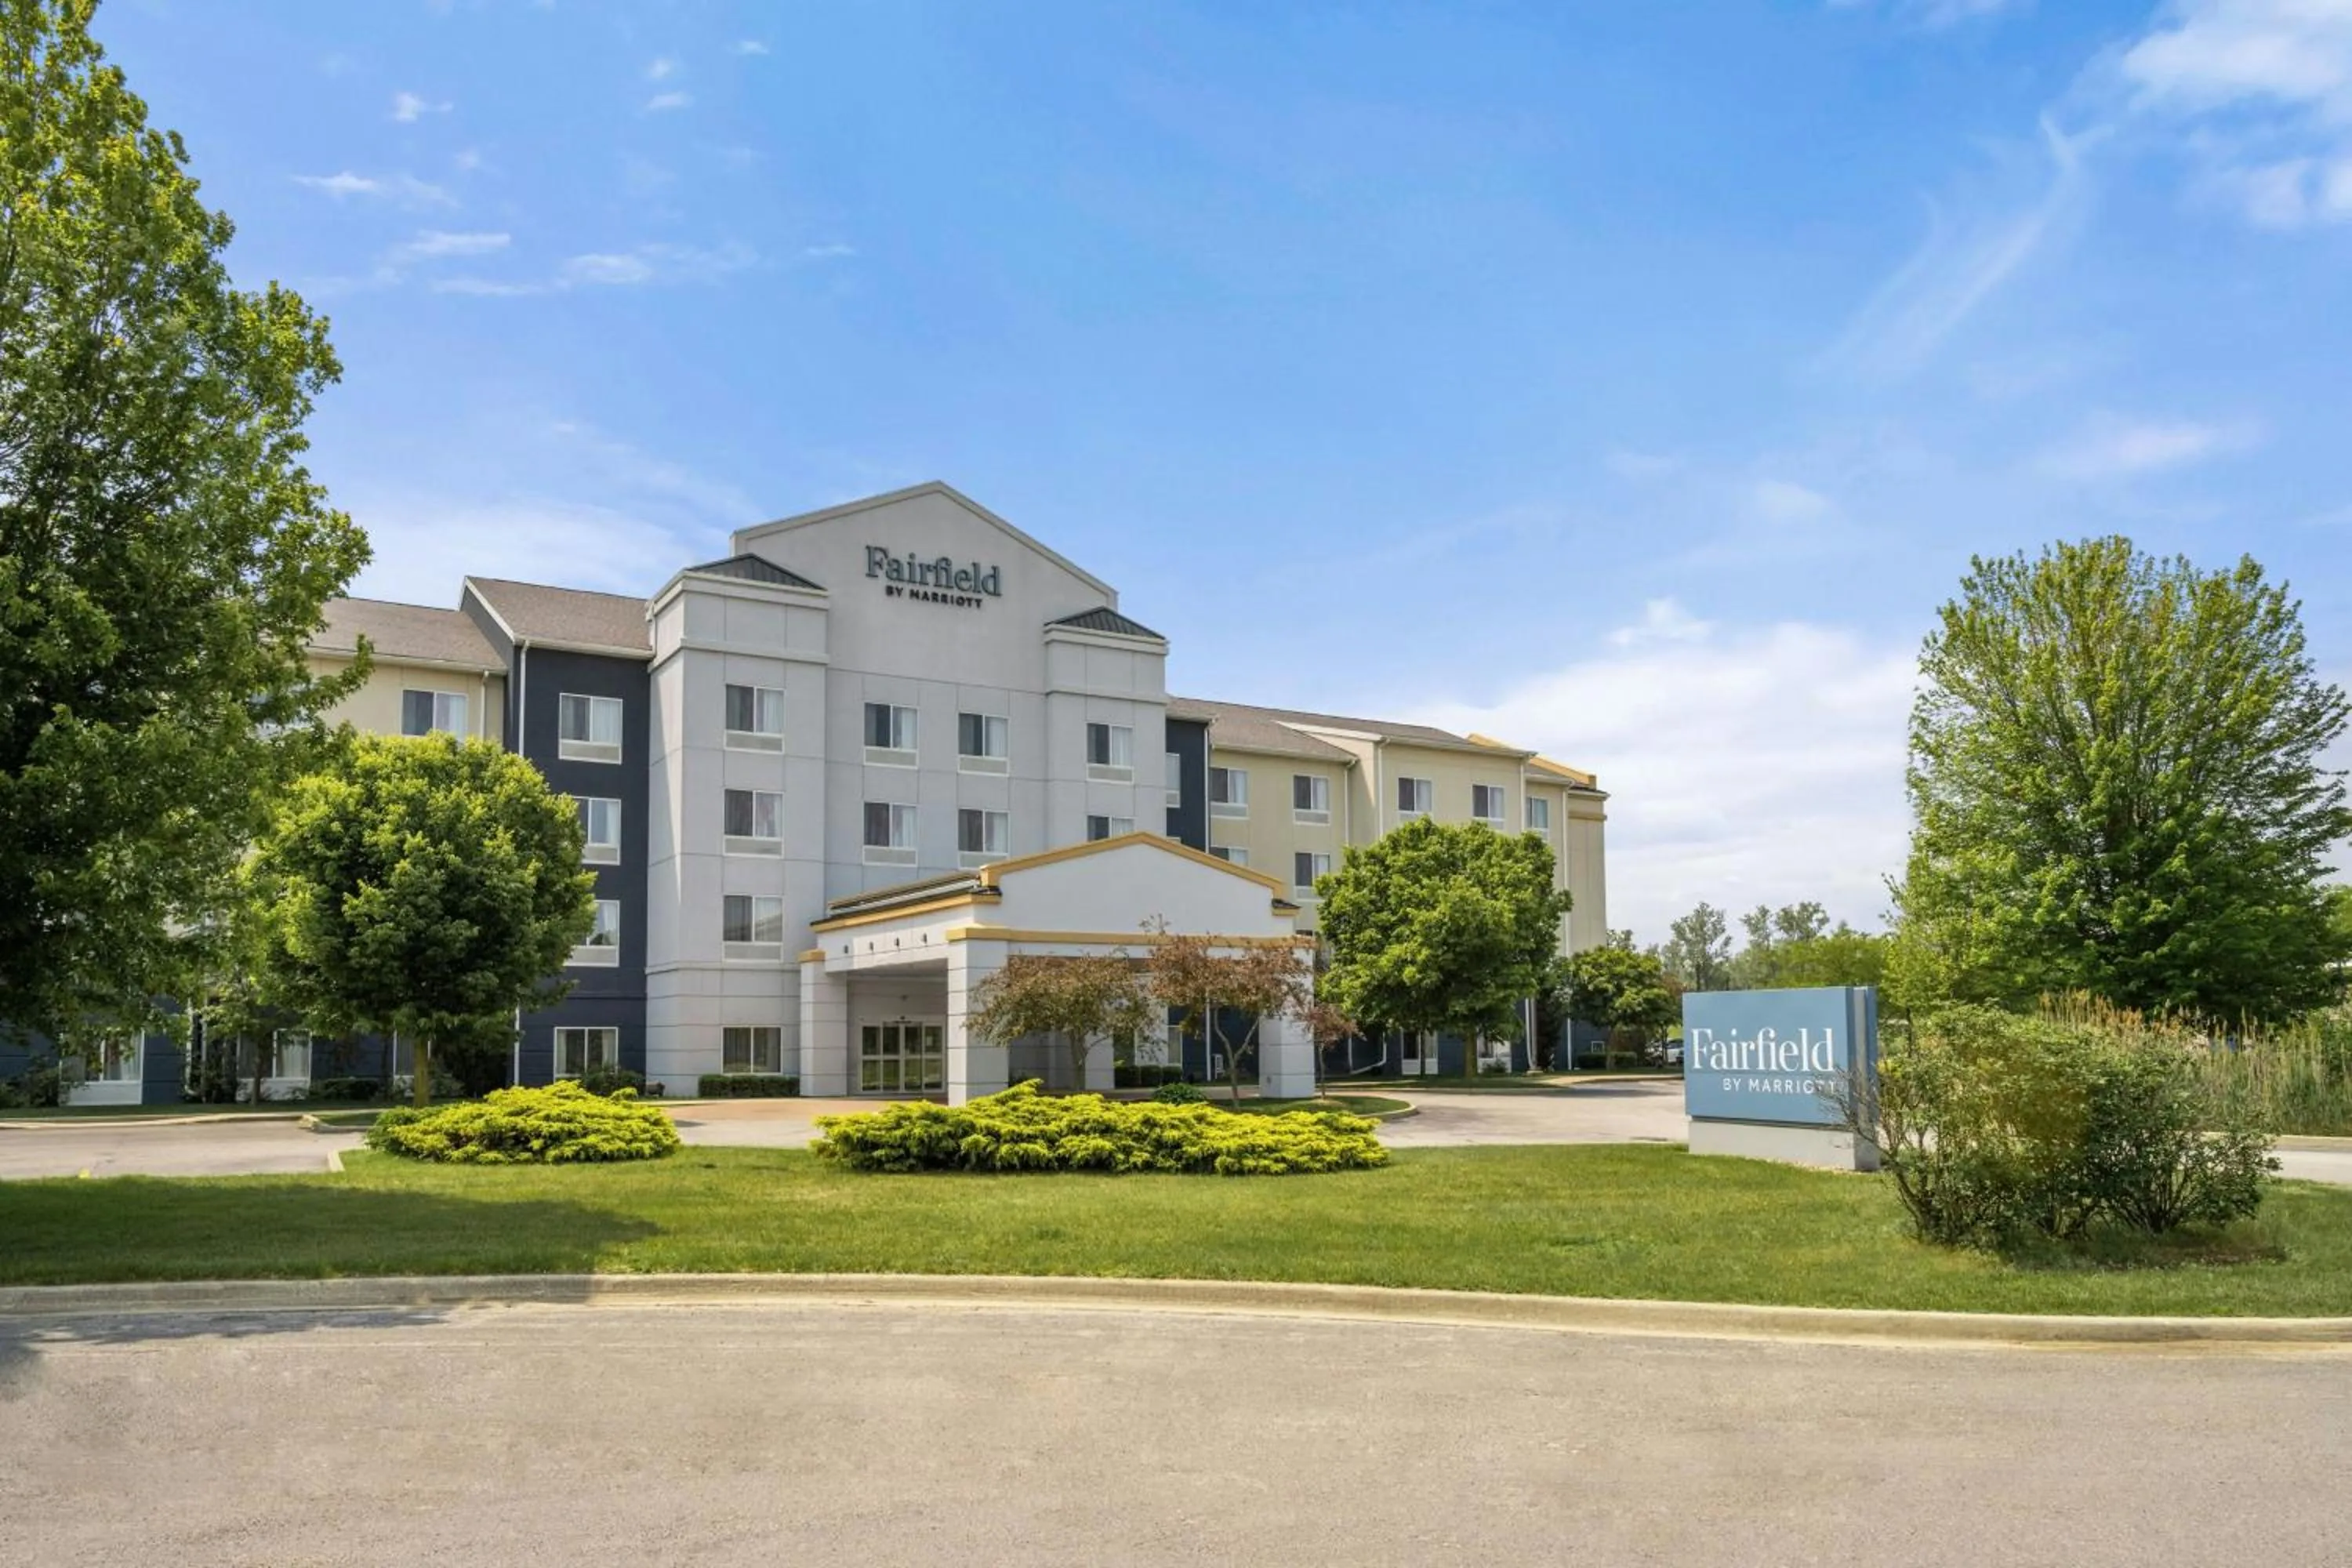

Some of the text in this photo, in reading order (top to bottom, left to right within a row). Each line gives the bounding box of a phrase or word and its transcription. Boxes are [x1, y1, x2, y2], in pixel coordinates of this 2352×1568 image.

[866, 545, 1003, 597] Fairfield
[885, 586, 983, 609] BY MARRIOTT
[1691, 1027, 1834, 1072] Fairfield
[1722, 1078, 1741, 1091] BY
